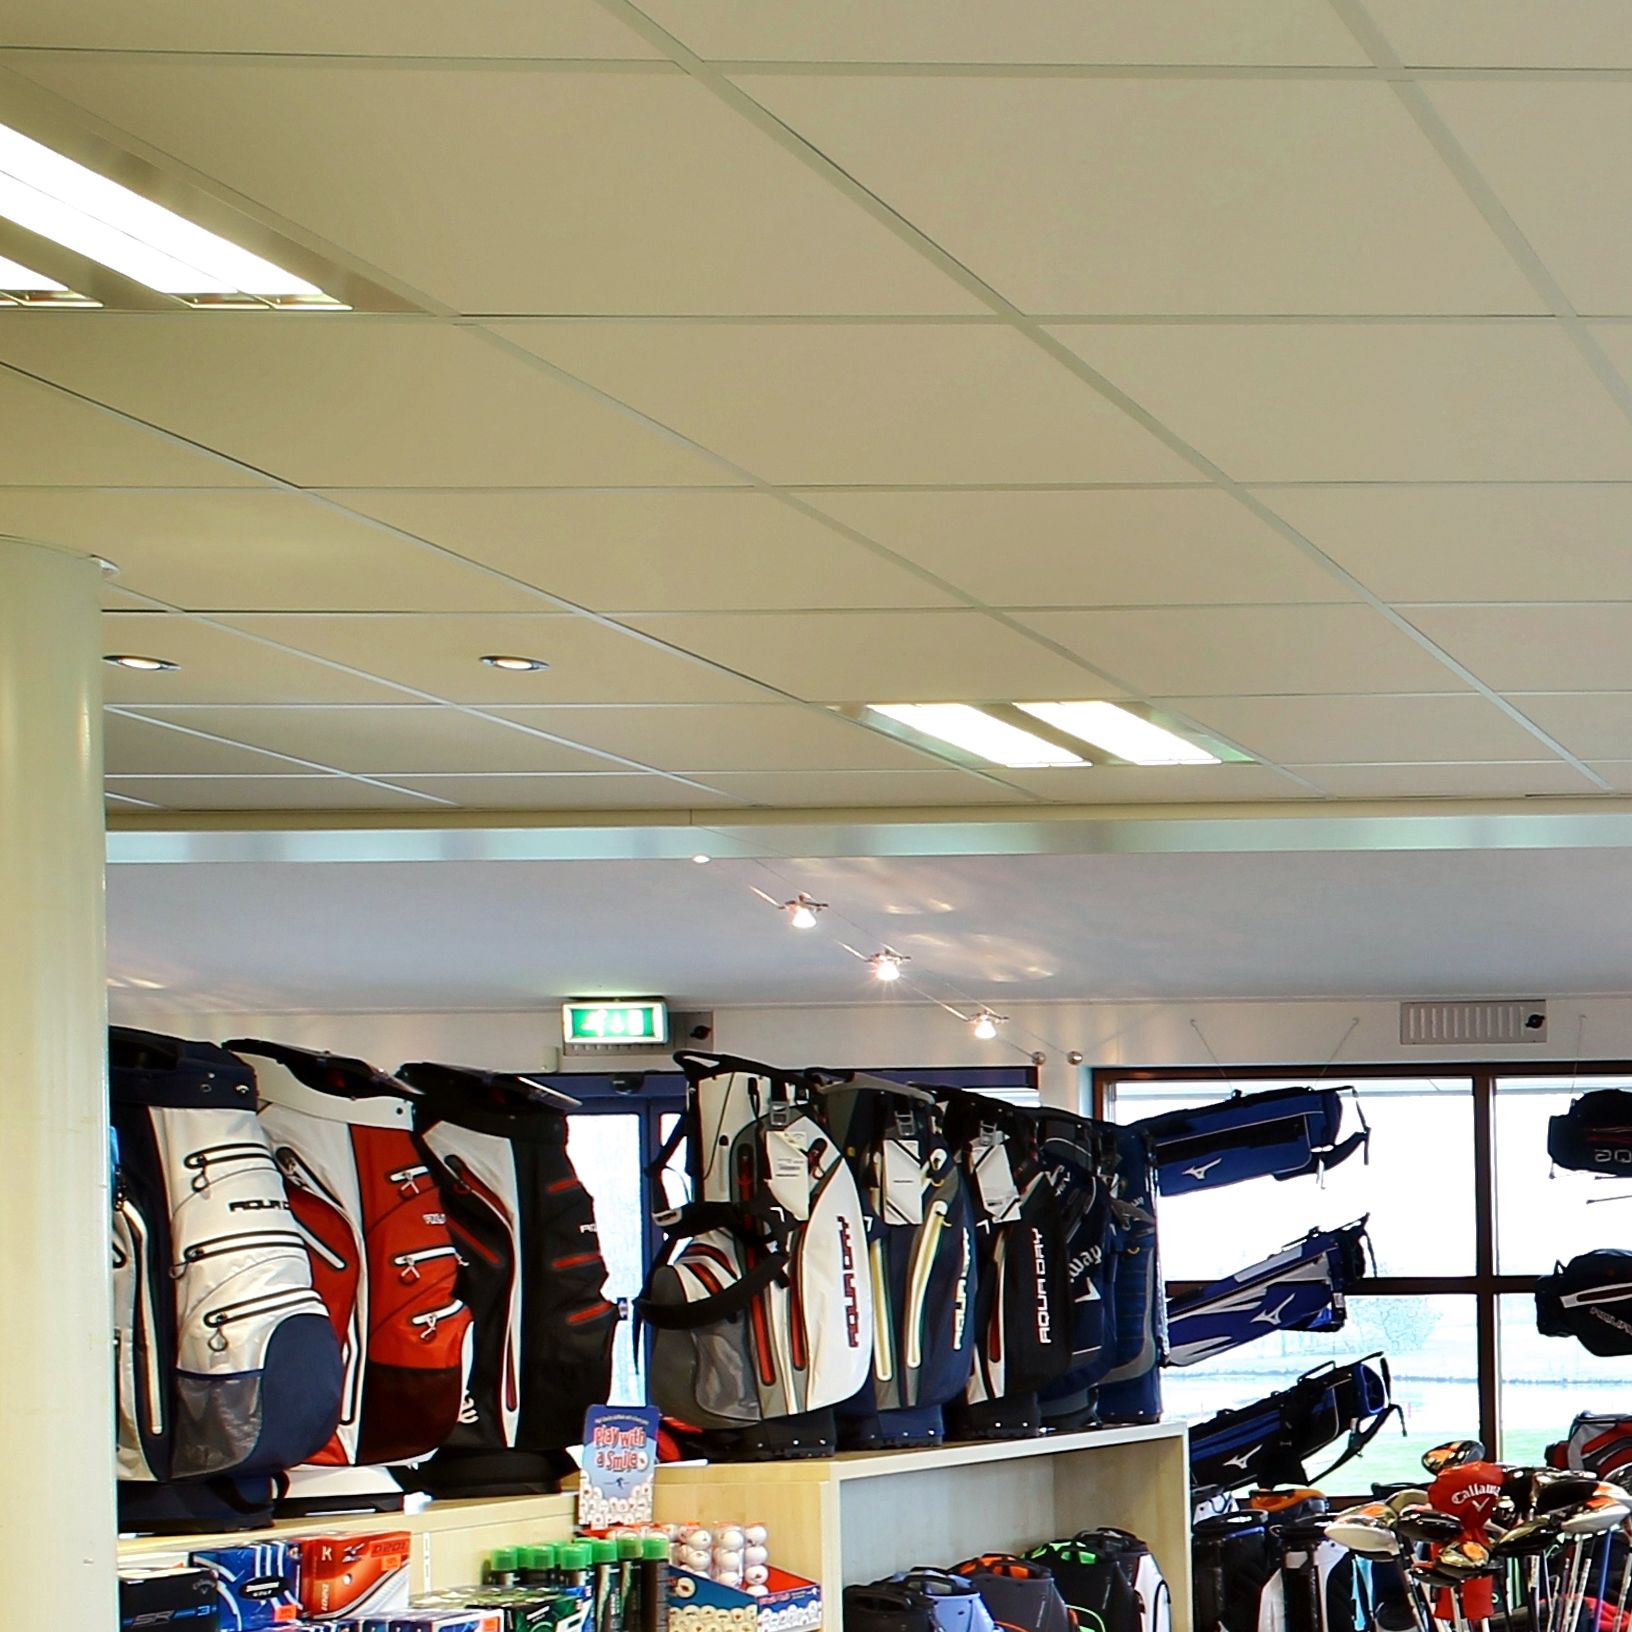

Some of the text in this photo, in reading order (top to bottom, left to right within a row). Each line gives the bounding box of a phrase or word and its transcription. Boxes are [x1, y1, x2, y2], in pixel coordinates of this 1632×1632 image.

[1031, 1227, 1052, 1344] AQUA DRY
[593, 1426, 647, 1449] Play with
[596, 1450, 638, 1472] a Smile
